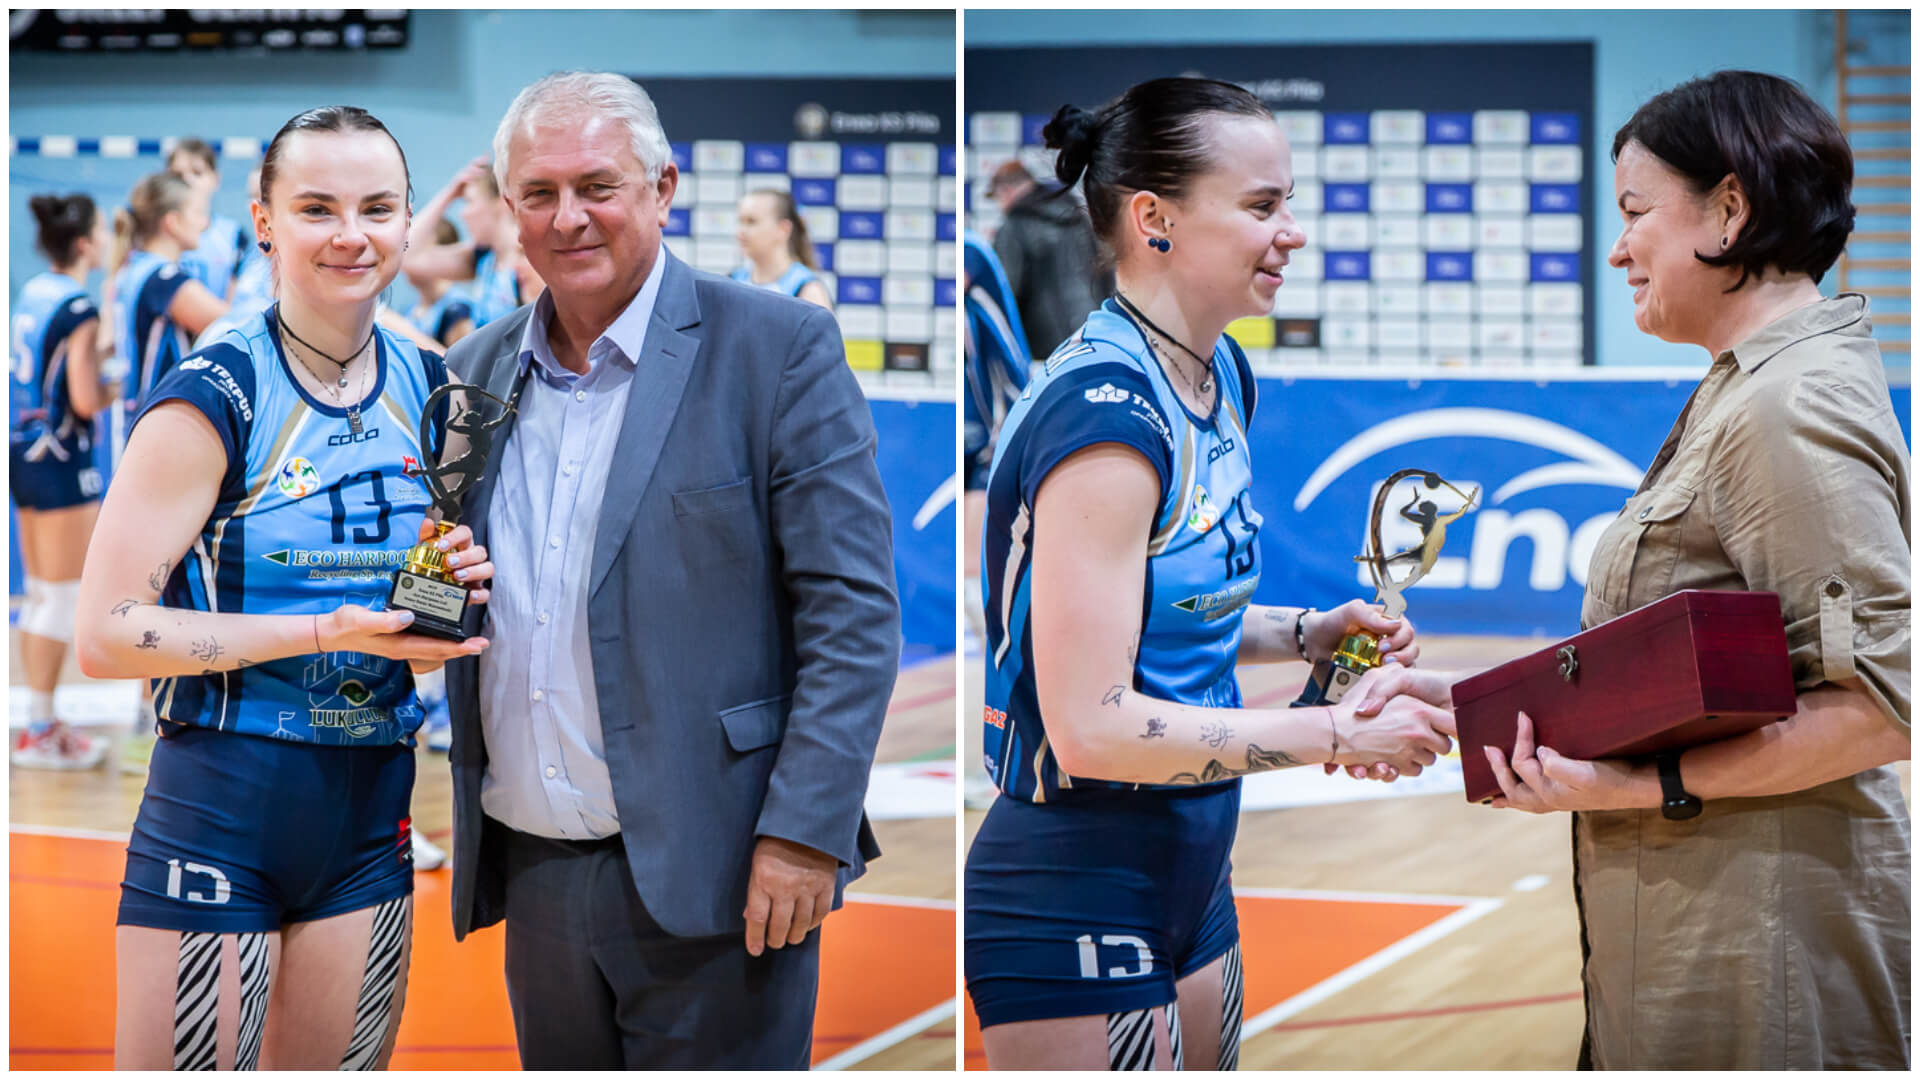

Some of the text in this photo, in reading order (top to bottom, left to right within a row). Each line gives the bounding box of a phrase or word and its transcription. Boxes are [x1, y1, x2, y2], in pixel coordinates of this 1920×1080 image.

[328, 470, 392, 544] 13
[293, 551, 411, 568] ECO HARPOO
